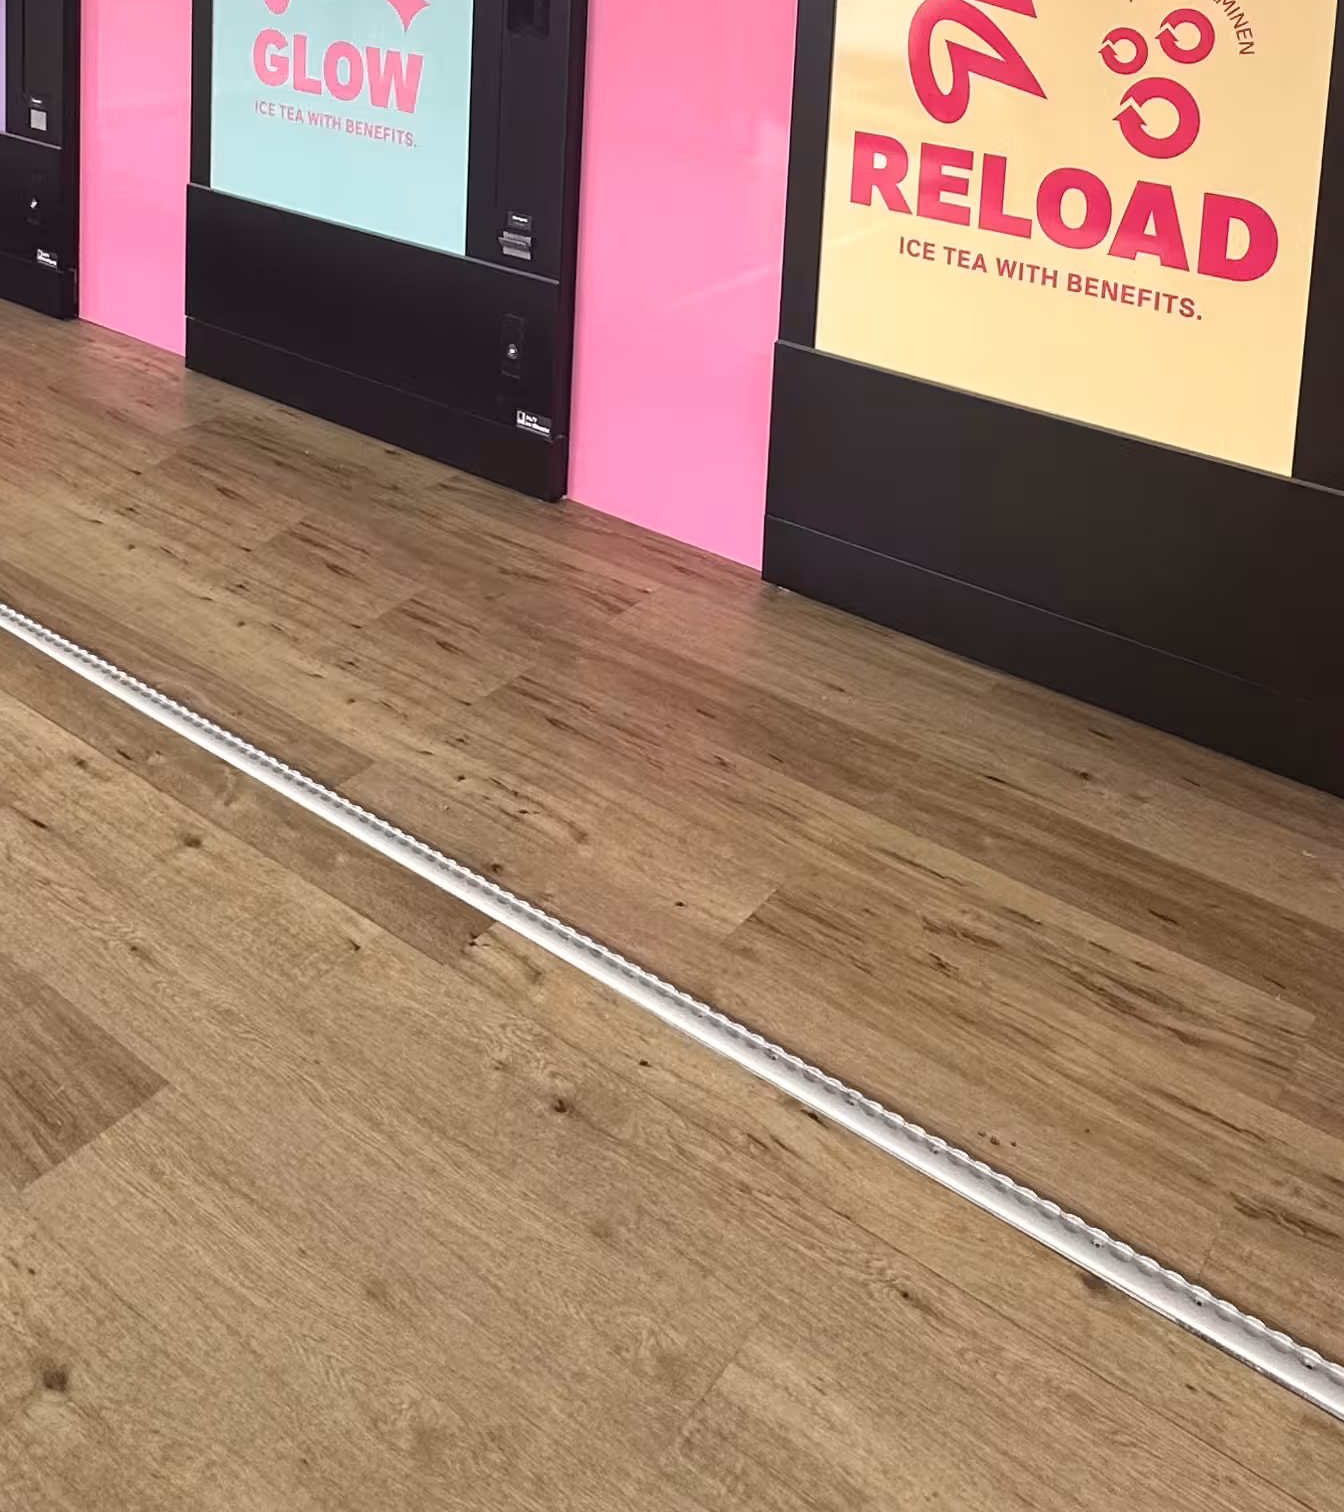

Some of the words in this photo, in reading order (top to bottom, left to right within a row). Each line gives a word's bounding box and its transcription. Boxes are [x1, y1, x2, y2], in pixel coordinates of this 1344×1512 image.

[253, 27, 424, 114] GLOW
[254, 100, 275, 117] ICE
[279, 103, 304, 123] TEA
[307, 109, 342, 131] WITH
[345, 118, 418, 148] BENEFITS.
[849, 128, 1279, 284] RELOAD
[899, 236, 936, 261] ICE
[943, 246, 988, 273] TEA
[996, 257, 1059, 289] WITH
[1067, 272, 1203, 320] BENEFITS.
